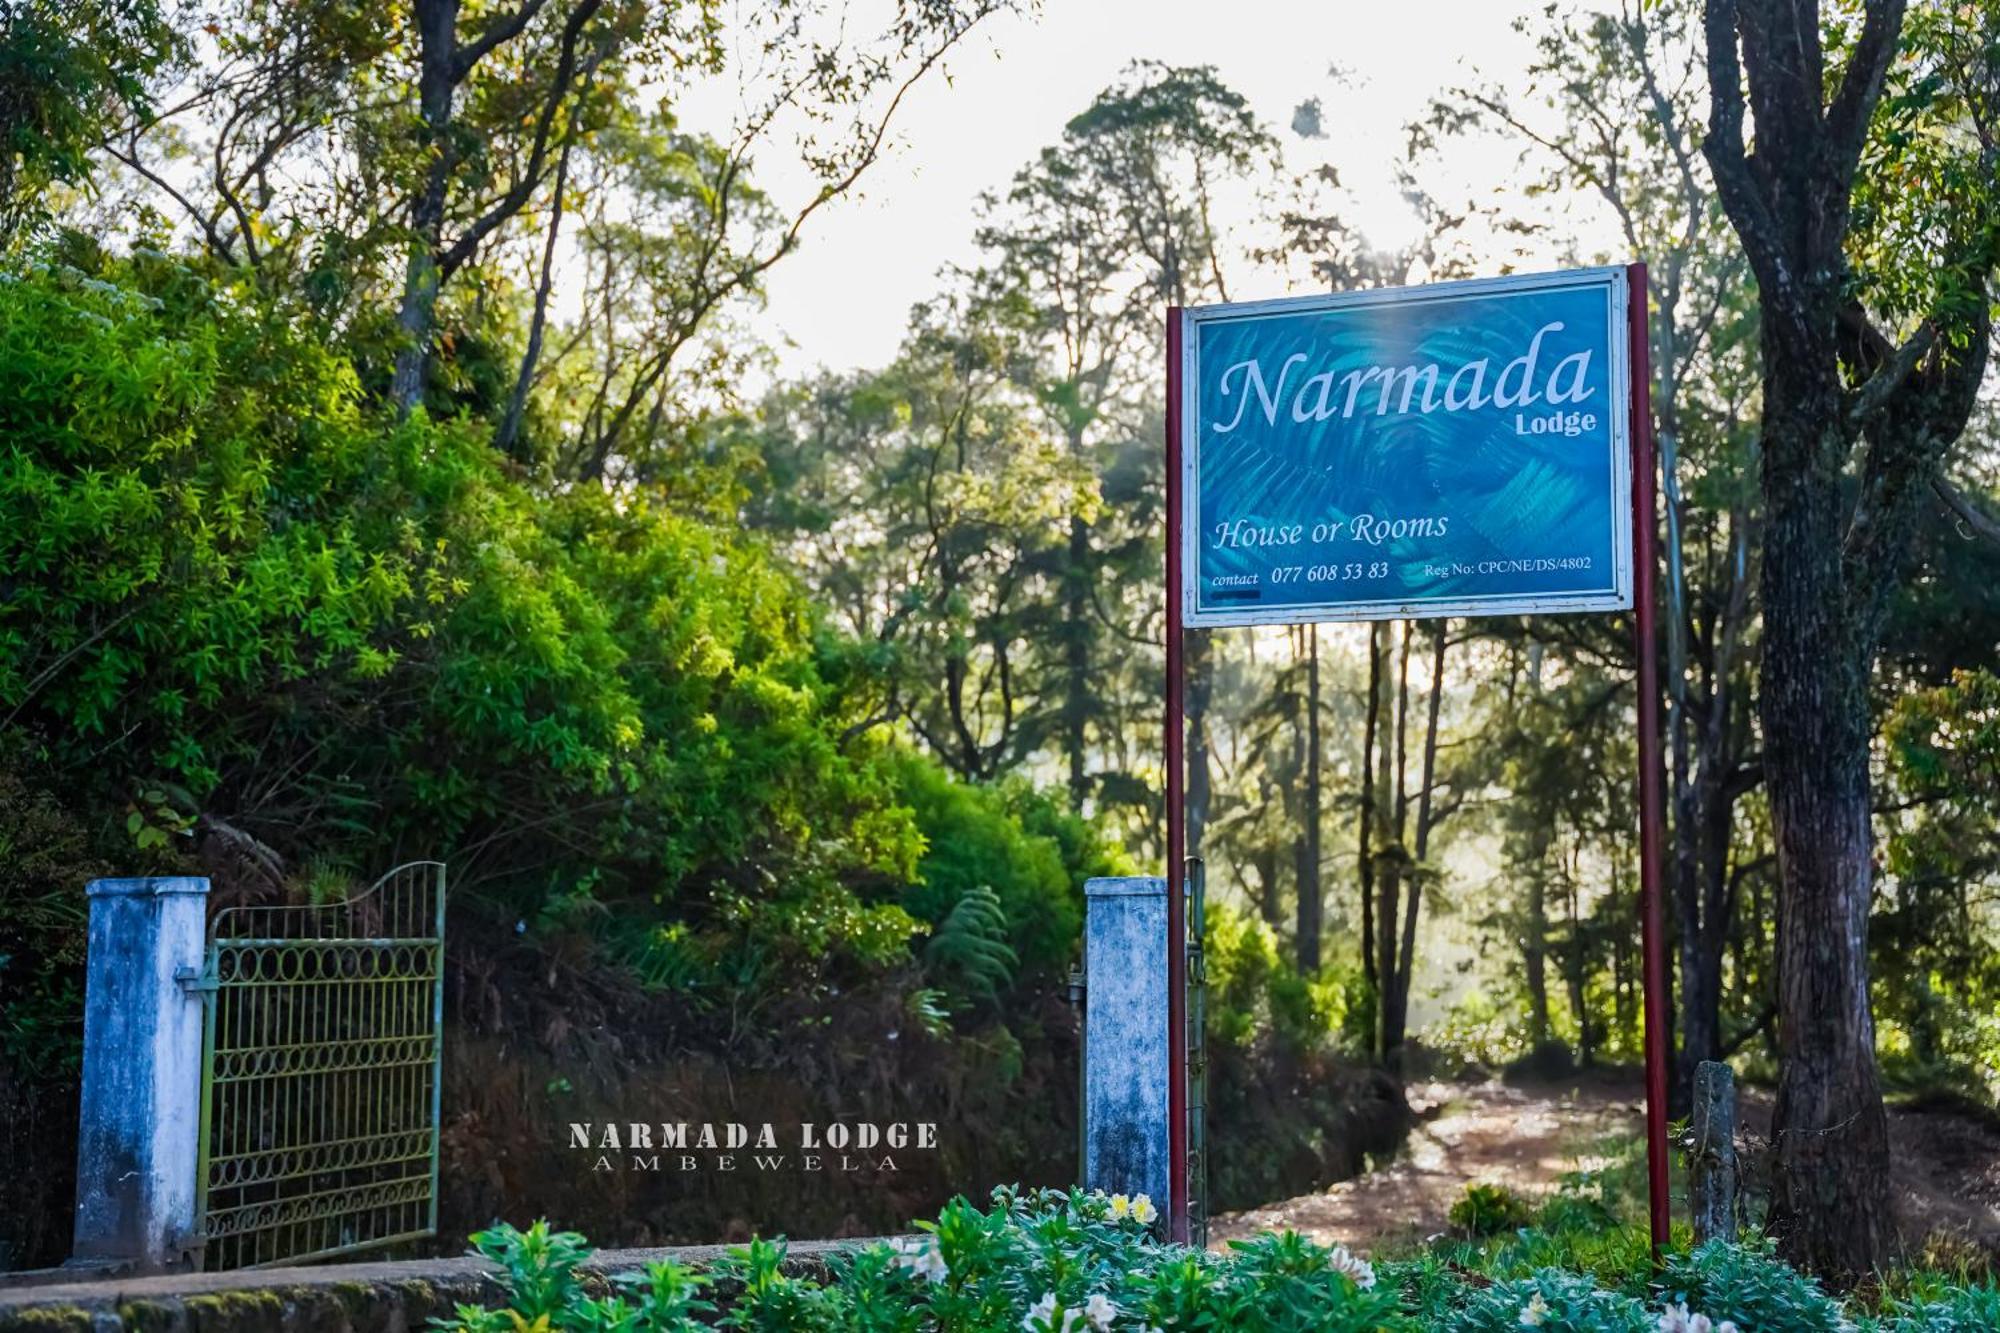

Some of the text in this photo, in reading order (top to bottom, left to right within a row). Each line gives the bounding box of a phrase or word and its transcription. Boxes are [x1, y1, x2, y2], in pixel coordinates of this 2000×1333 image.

[1212, 321, 1596, 433] Narmada
[1516, 410, 1598, 436] Lodge
[1213, 514, 1449, 549] House or Rooms
[1212, 561, 1389, 586] contact 077 608 53 83
[1424, 557, 1591, 578] Reg No: CPC/NE/DS/4802
